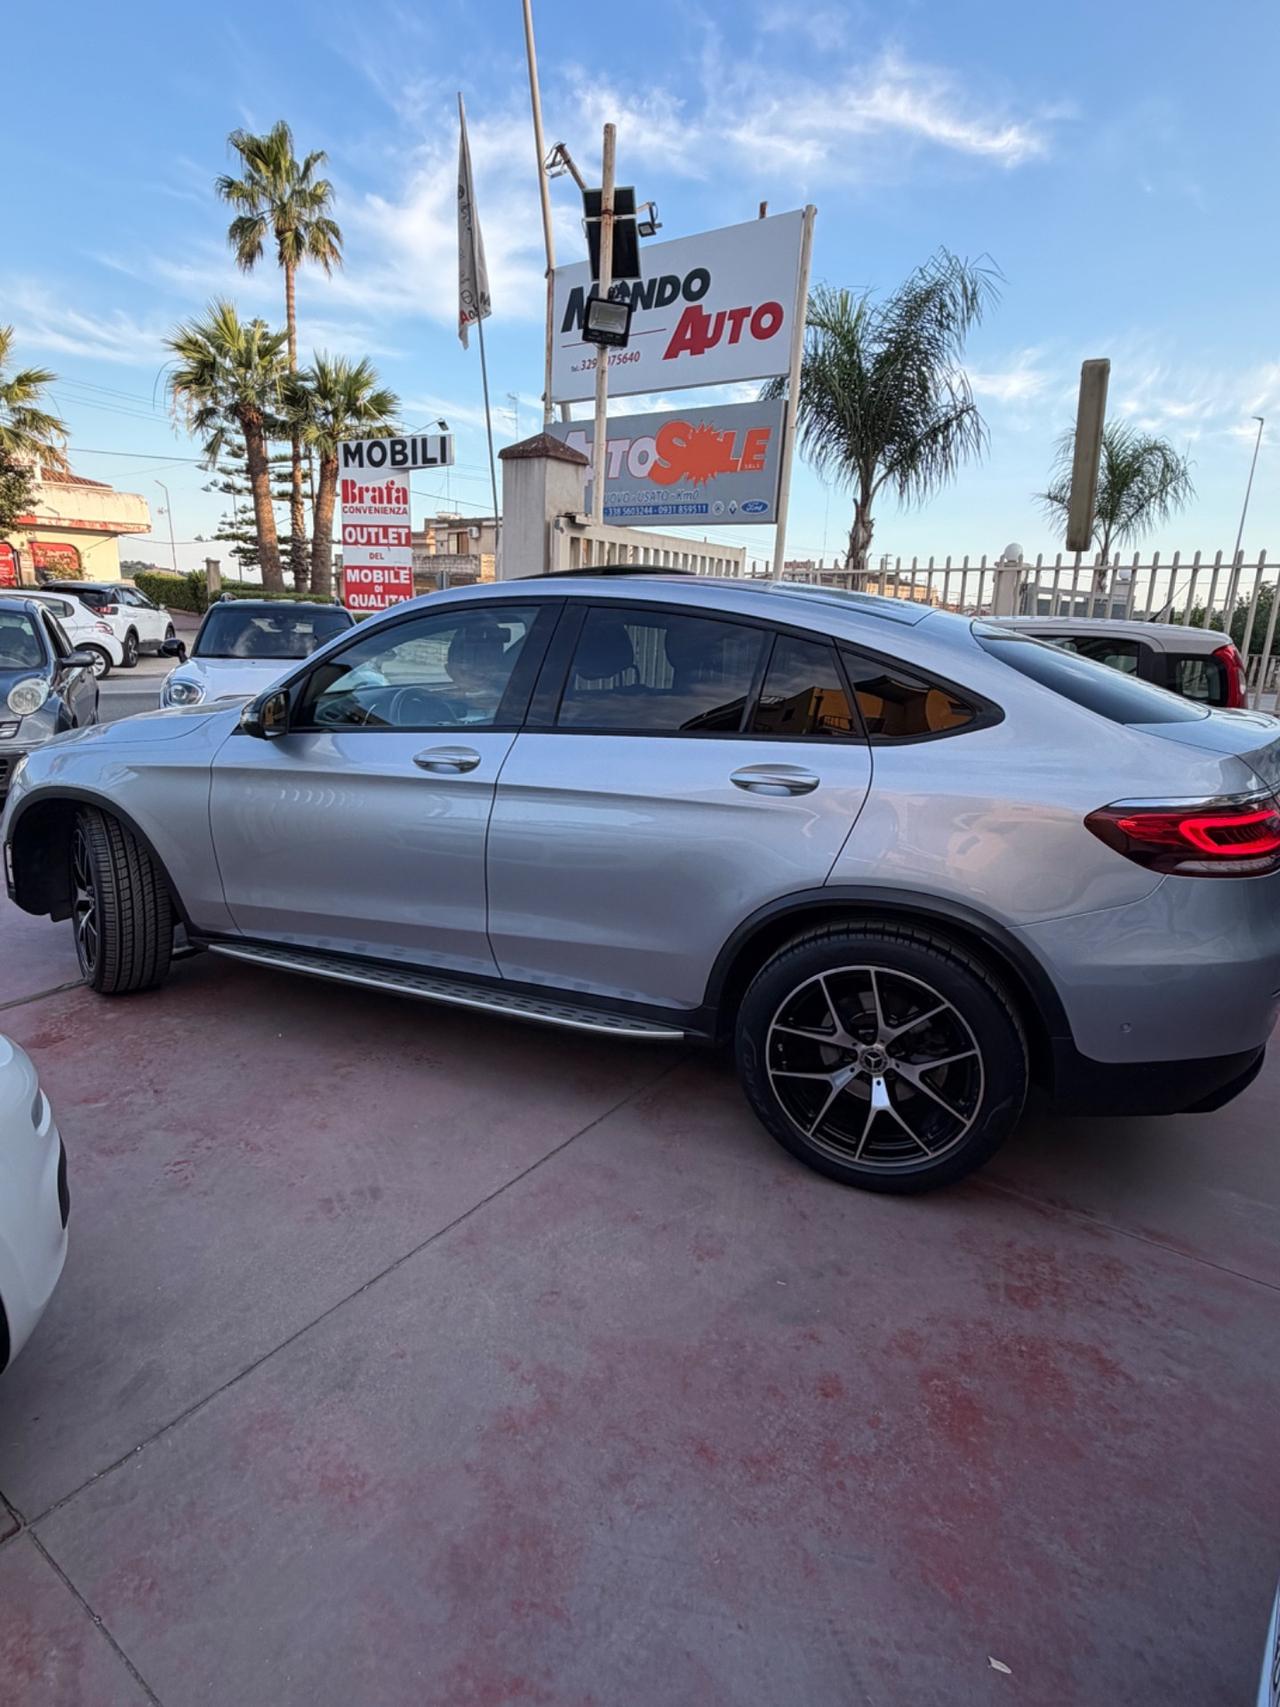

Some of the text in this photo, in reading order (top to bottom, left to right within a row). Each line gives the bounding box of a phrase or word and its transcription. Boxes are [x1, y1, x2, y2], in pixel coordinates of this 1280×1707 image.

[561, 267, 711, 333] MNDO
[662, 301, 784, 361] AUTO
[580, 351, 641, 371] 32975640
[342, 436, 447, 468] MOBILI
[341, 479, 408, 505] Brafa
[342, 505, 408, 515] CONVENIENZA
[344, 527, 409, 544] OUTLET
[369, 552, 384, 560] DEL
[346, 568, 411, 584] MOBILE
[374, 584, 384, 593] DI
